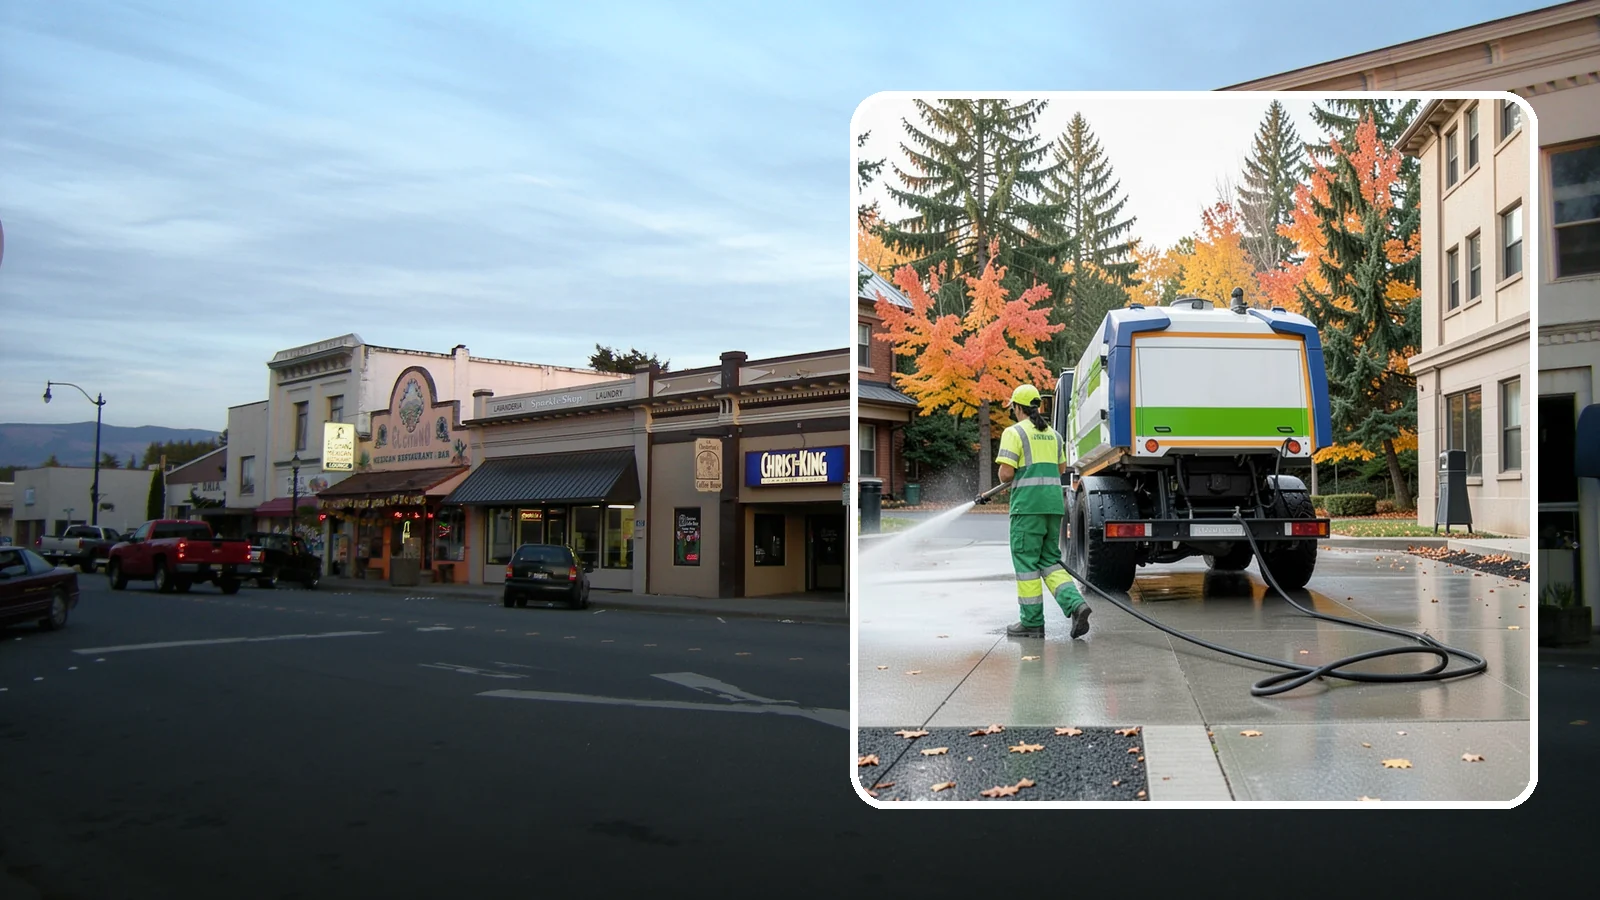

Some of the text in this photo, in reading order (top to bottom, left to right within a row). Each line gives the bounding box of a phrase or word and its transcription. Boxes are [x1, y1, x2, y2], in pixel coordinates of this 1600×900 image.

[530, 394, 582, 408] Sparkle Shop
[595, 388, 624, 400] LAUNDRY
[493, 401, 523, 413] LAVANDERIA
[373, 450, 450, 465] MEXICAN RESTAURANT BAR
[800, 450, 827, 476] KING
